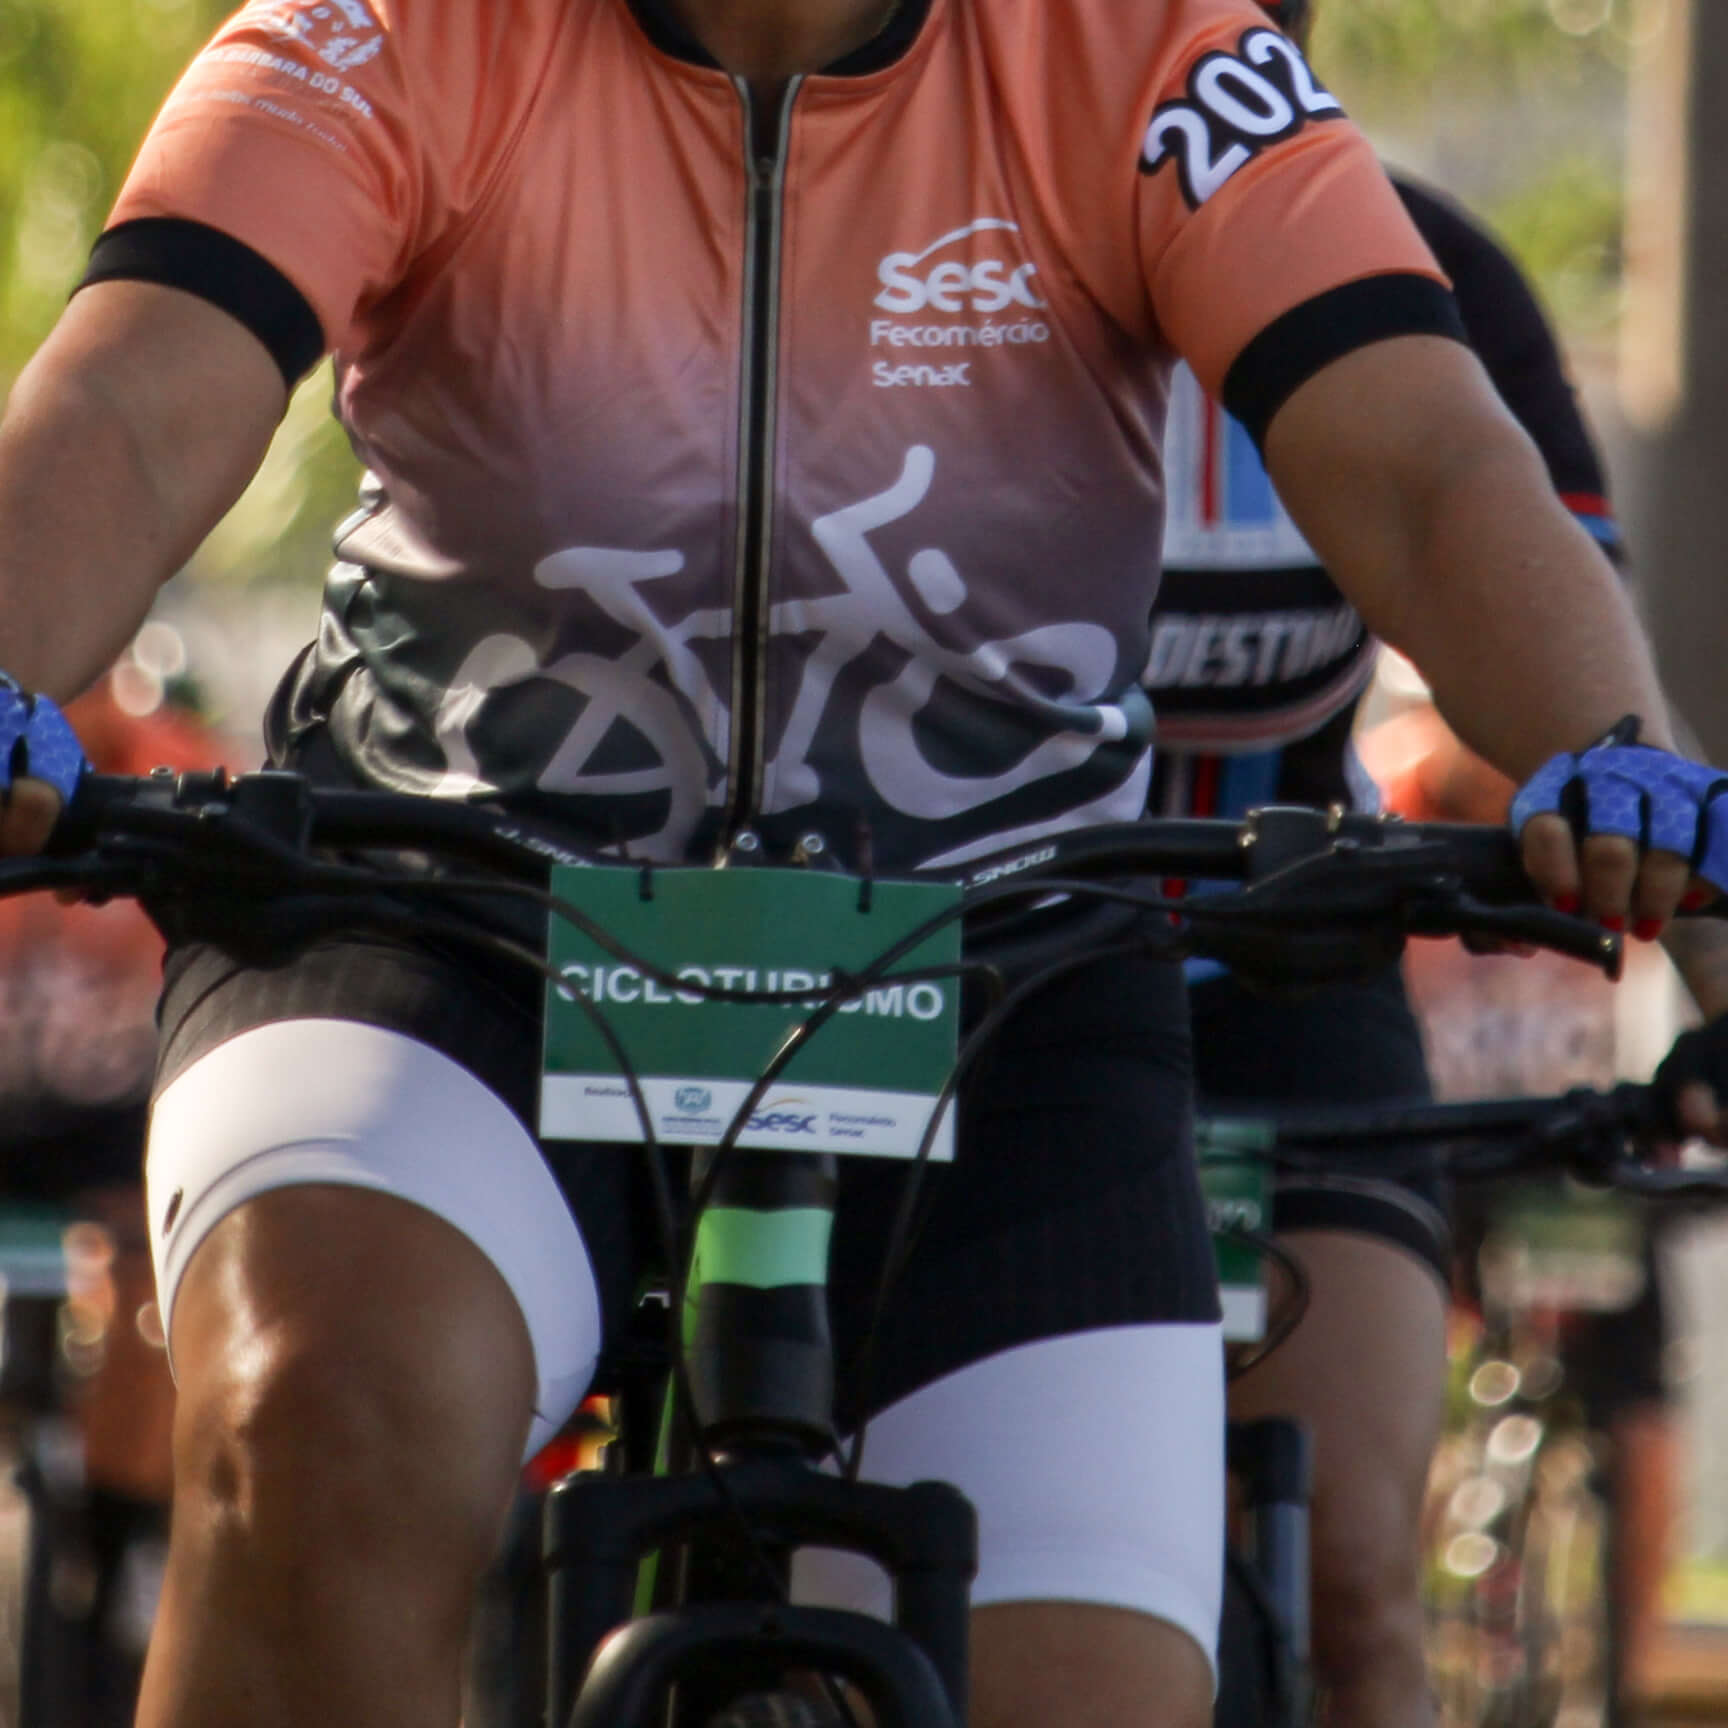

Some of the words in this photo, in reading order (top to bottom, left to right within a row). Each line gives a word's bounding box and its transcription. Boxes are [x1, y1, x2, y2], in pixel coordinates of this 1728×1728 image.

[309, 72, 340, 95] DO
[339, 85, 373, 120] SUL
[874, 234, 1047, 314] Sesc
[869, 319, 1049, 347] Fecomércio
[872, 360, 971, 387] Senac
